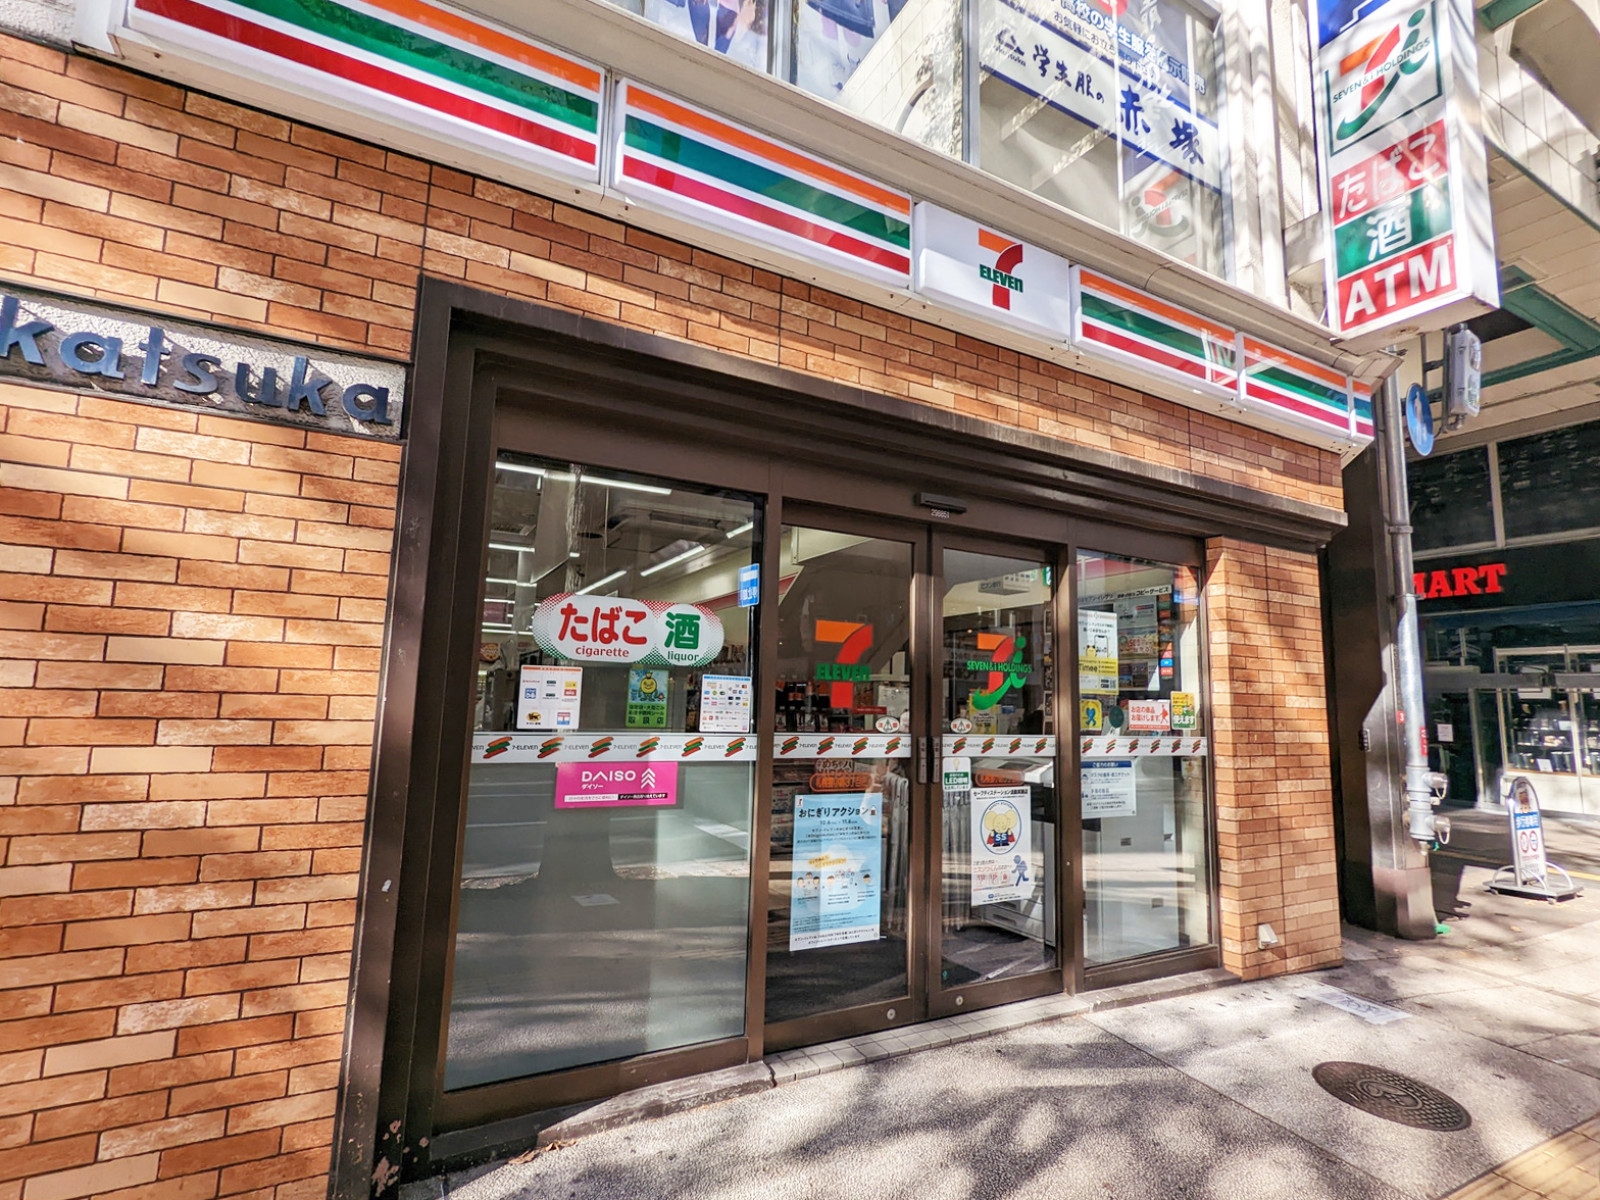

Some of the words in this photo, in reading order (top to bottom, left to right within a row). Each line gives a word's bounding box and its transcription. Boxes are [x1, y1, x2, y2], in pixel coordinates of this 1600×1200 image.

[1376, 36, 1431, 77] HOLDINGS
[1338, 133, 1439, 219] たばこ
[1366, 205, 1413, 261] 酒
[1344, 244, 1451, 324] ATM
[0, 295, 392, 425] katsuka
[558, 602, 647, 645] たばこ
[664, 611, 701, 649] 酒
[575, 645, 630, 658] cigarette
[667, 650, 700, 661] liquor
[998, 662, 1033, 673] HOLDINGS
[581, 770, 637, 782] DAISO
[799, 806, 869, 818] おにぎりアクション
